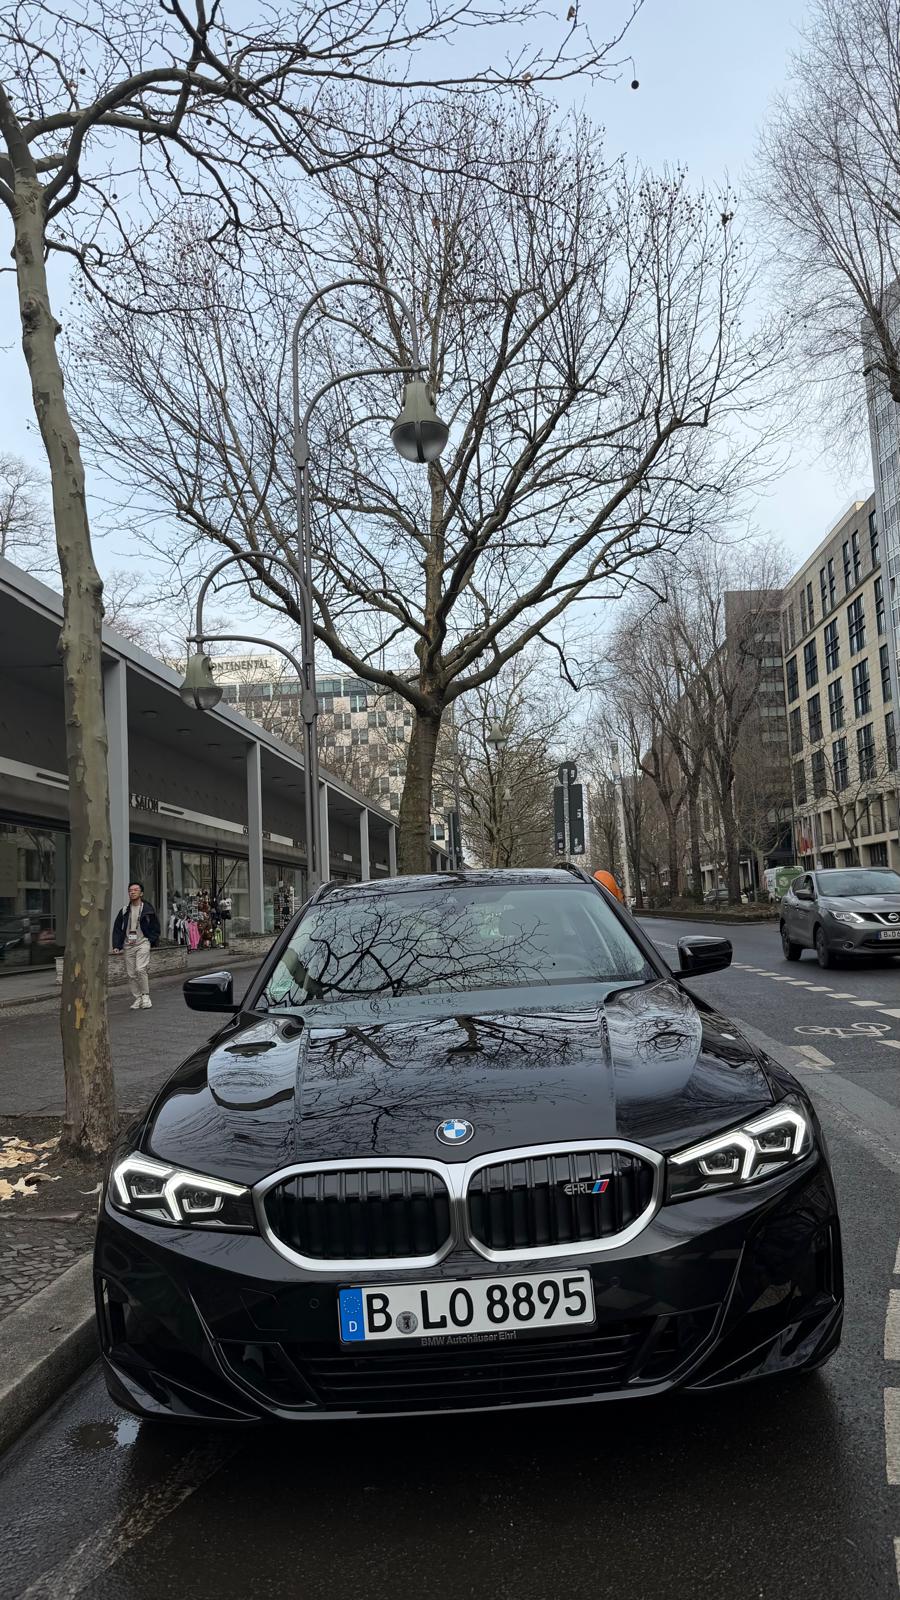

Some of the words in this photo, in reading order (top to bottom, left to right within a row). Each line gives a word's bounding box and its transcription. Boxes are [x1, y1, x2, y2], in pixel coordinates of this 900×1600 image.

[210, 659, 271, 671] ONTINENTAL
[348, 1320, 358, 1332] D
[366, 1293, 393, 1334] B
[420, 1287, 474, 1330] LO
[485, 1276, 587, 1324] 8895
[421, 1336, 445, 1347] BMW
